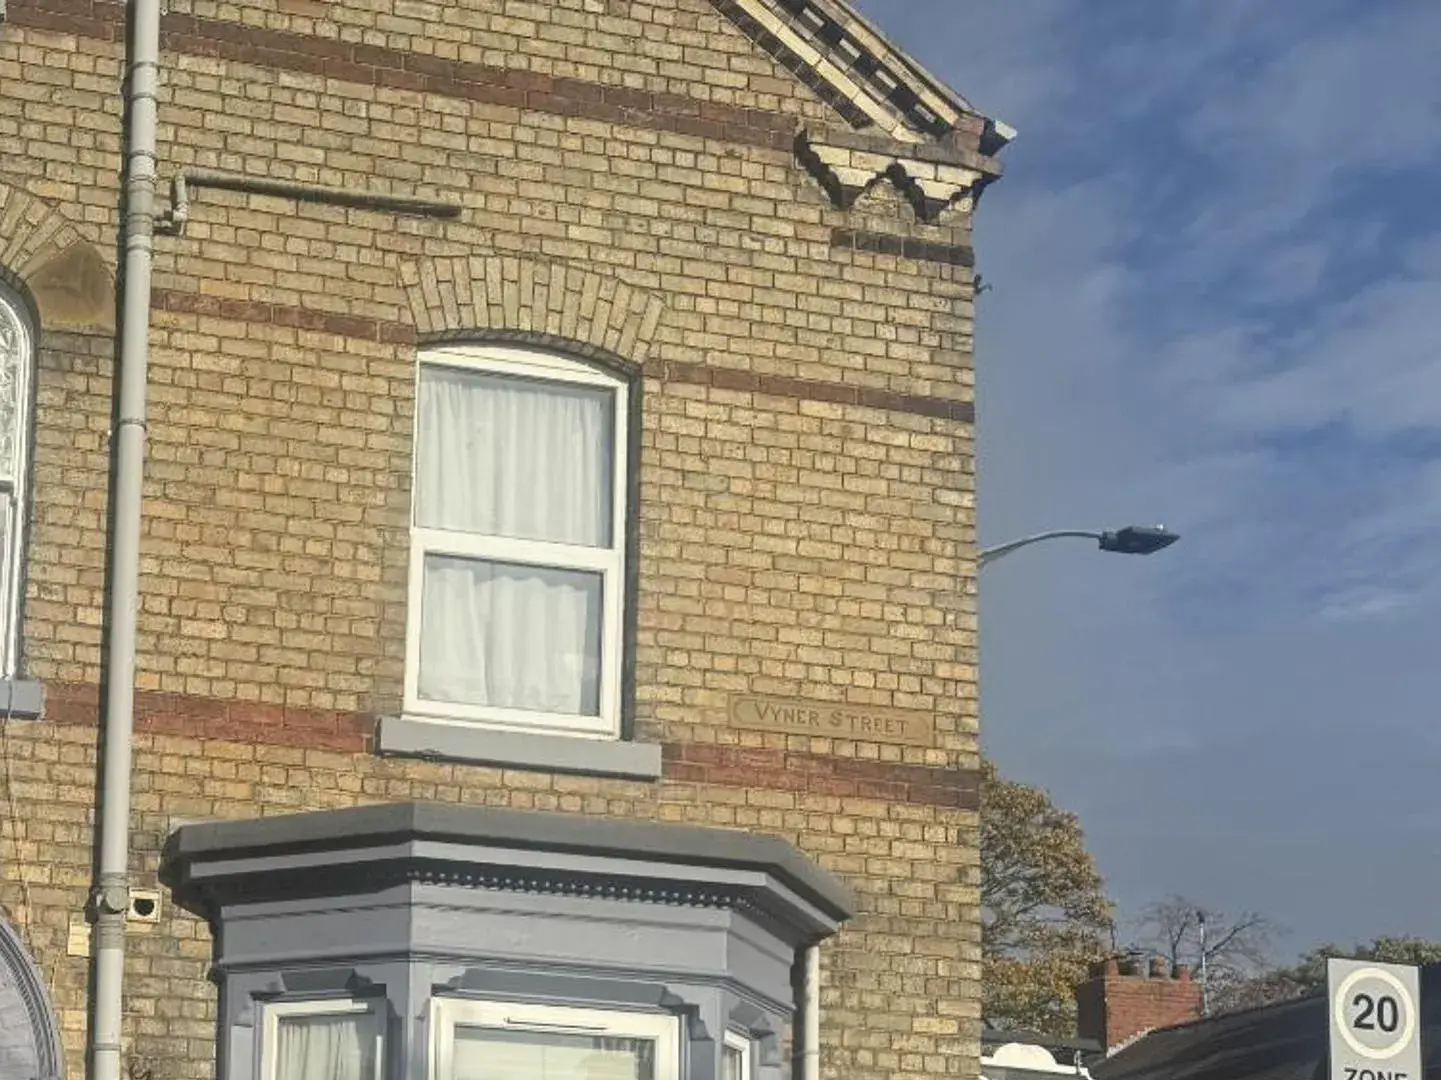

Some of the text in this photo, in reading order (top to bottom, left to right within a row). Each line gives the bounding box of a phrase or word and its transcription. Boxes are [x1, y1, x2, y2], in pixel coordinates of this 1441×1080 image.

[754, 701, 908, 735] VYNER STREET
[1352, 993, 1399, 1032] 20
